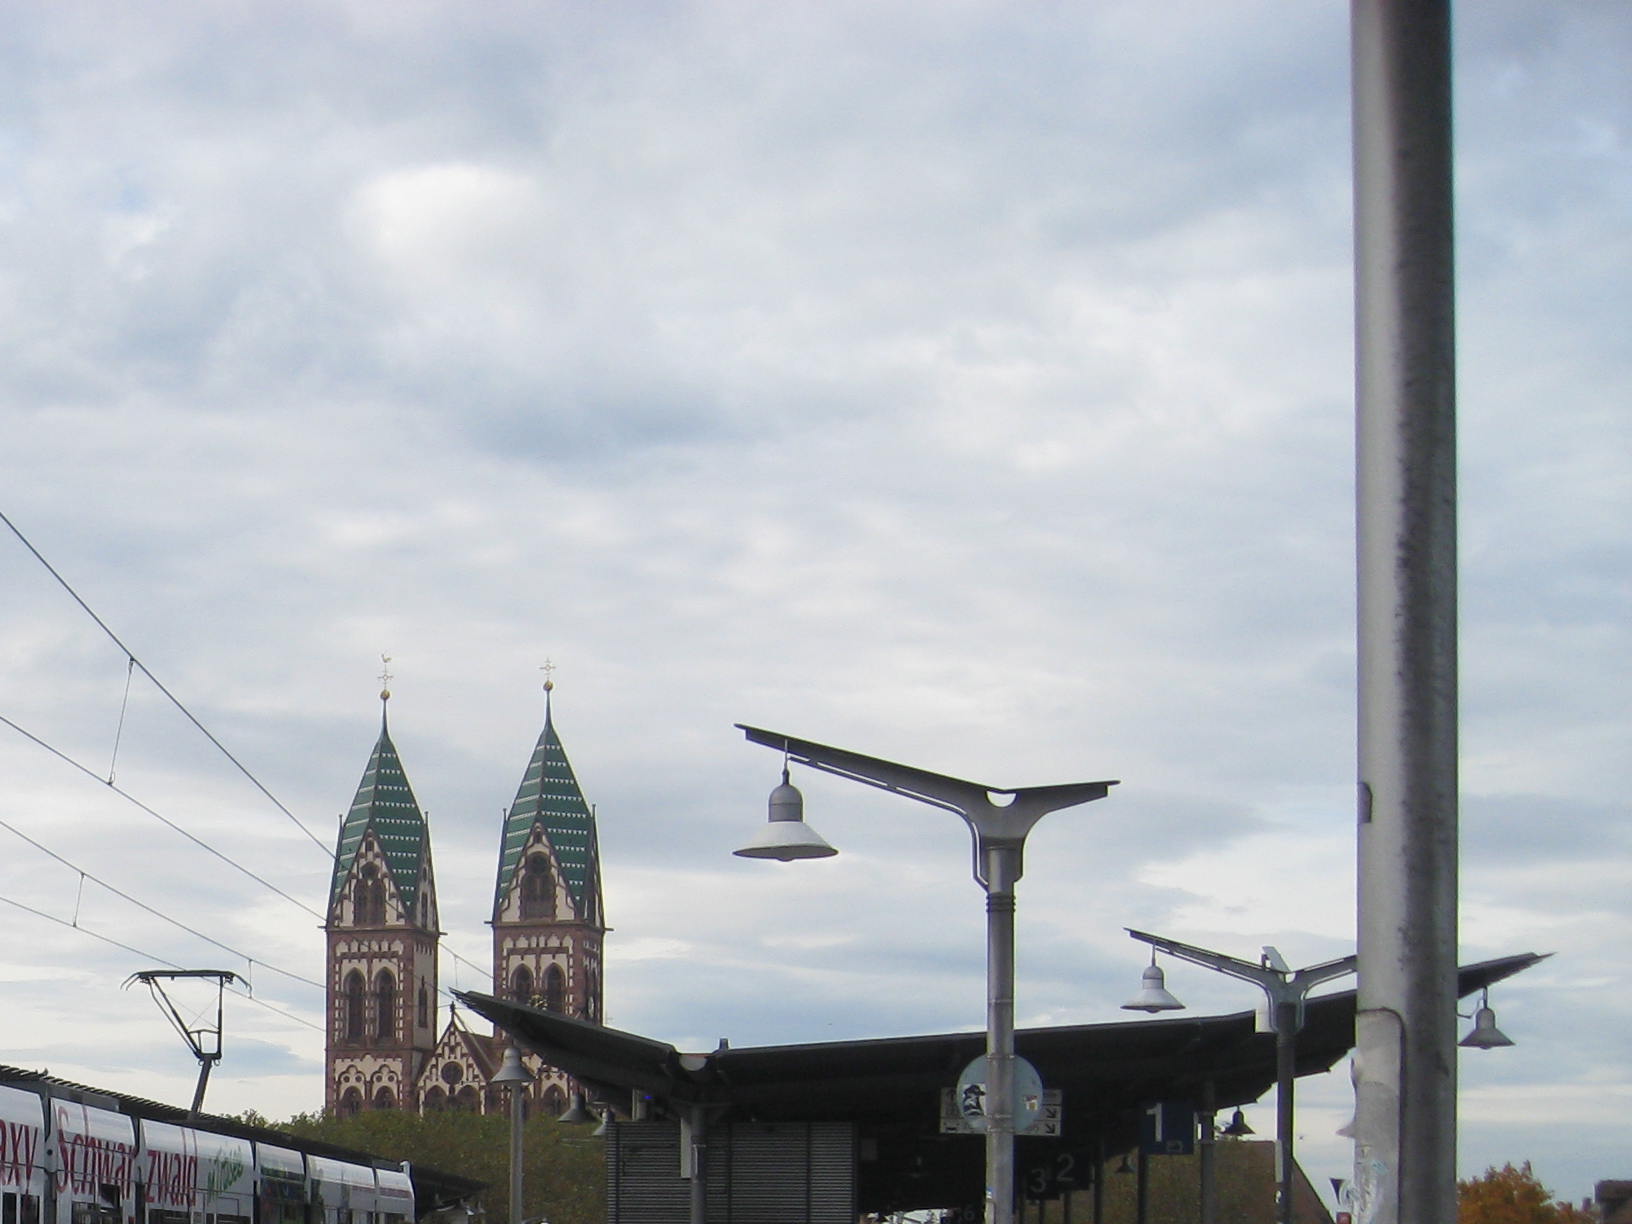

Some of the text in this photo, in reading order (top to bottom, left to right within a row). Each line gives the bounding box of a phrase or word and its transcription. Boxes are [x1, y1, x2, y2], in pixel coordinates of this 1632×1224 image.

[1146, 1102, 1163, 1142] 1
[1030, 1168, 1048, 1194] 3
[1056, 1153, 1074, 1183] 2
